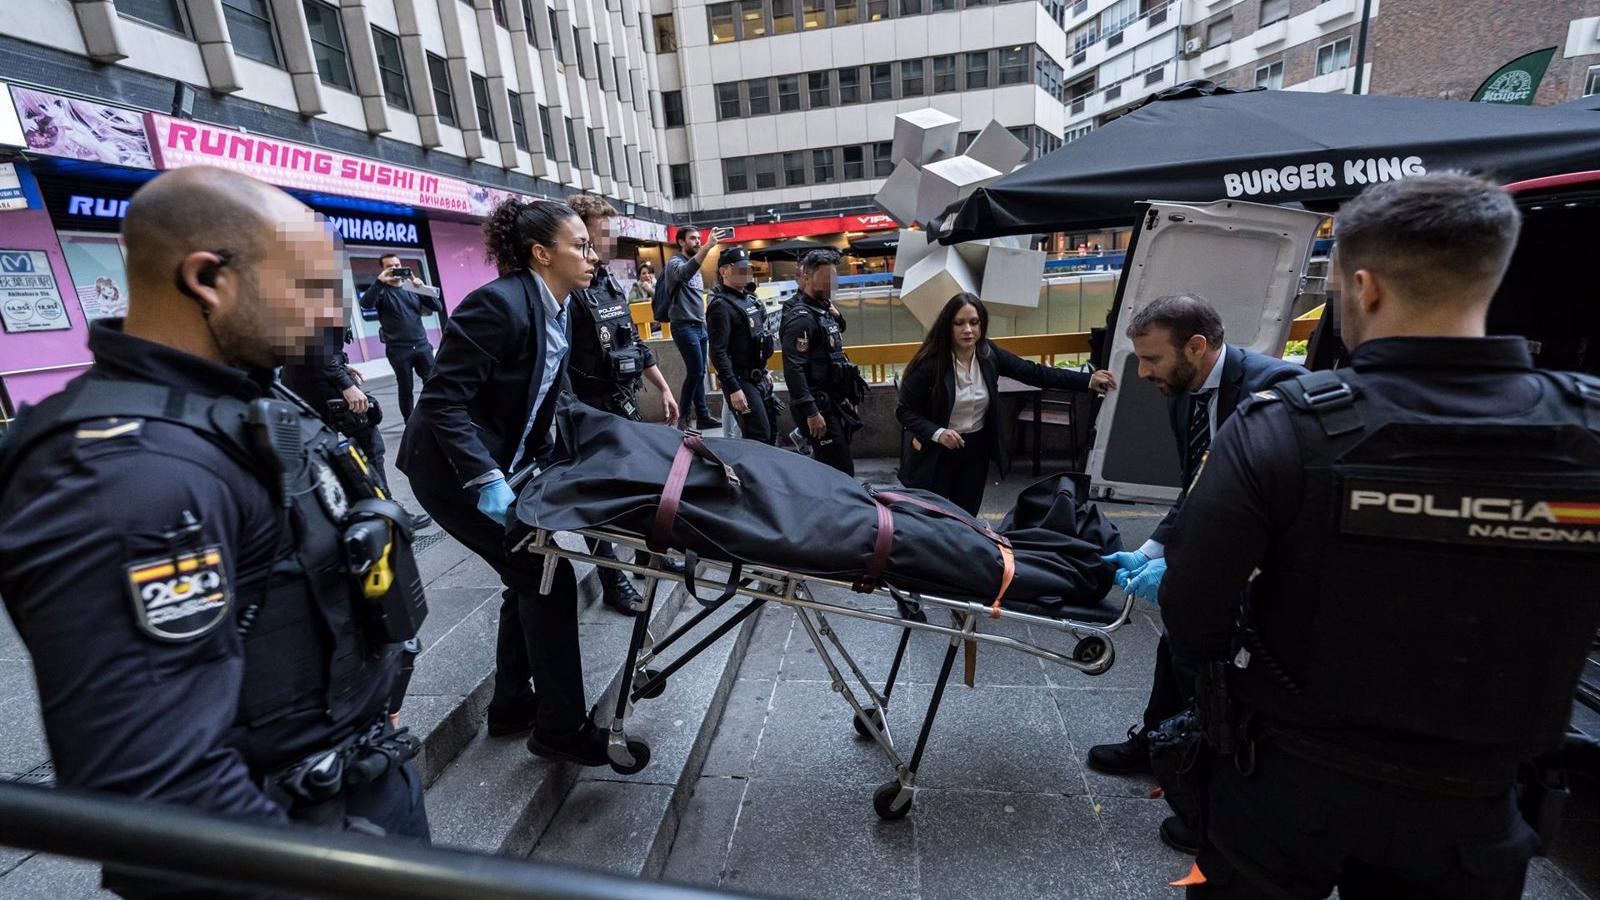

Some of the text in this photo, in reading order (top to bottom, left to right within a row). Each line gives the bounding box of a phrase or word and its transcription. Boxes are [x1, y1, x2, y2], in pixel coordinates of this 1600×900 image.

[167, 123, 439, 194] RUNNING SUSHI IN
[1224, 156, 1426, 197] BURGER KING
[419, 194, 468, 210] AKIHABARA
[1468, 523, 1600, 544] NACIONA
